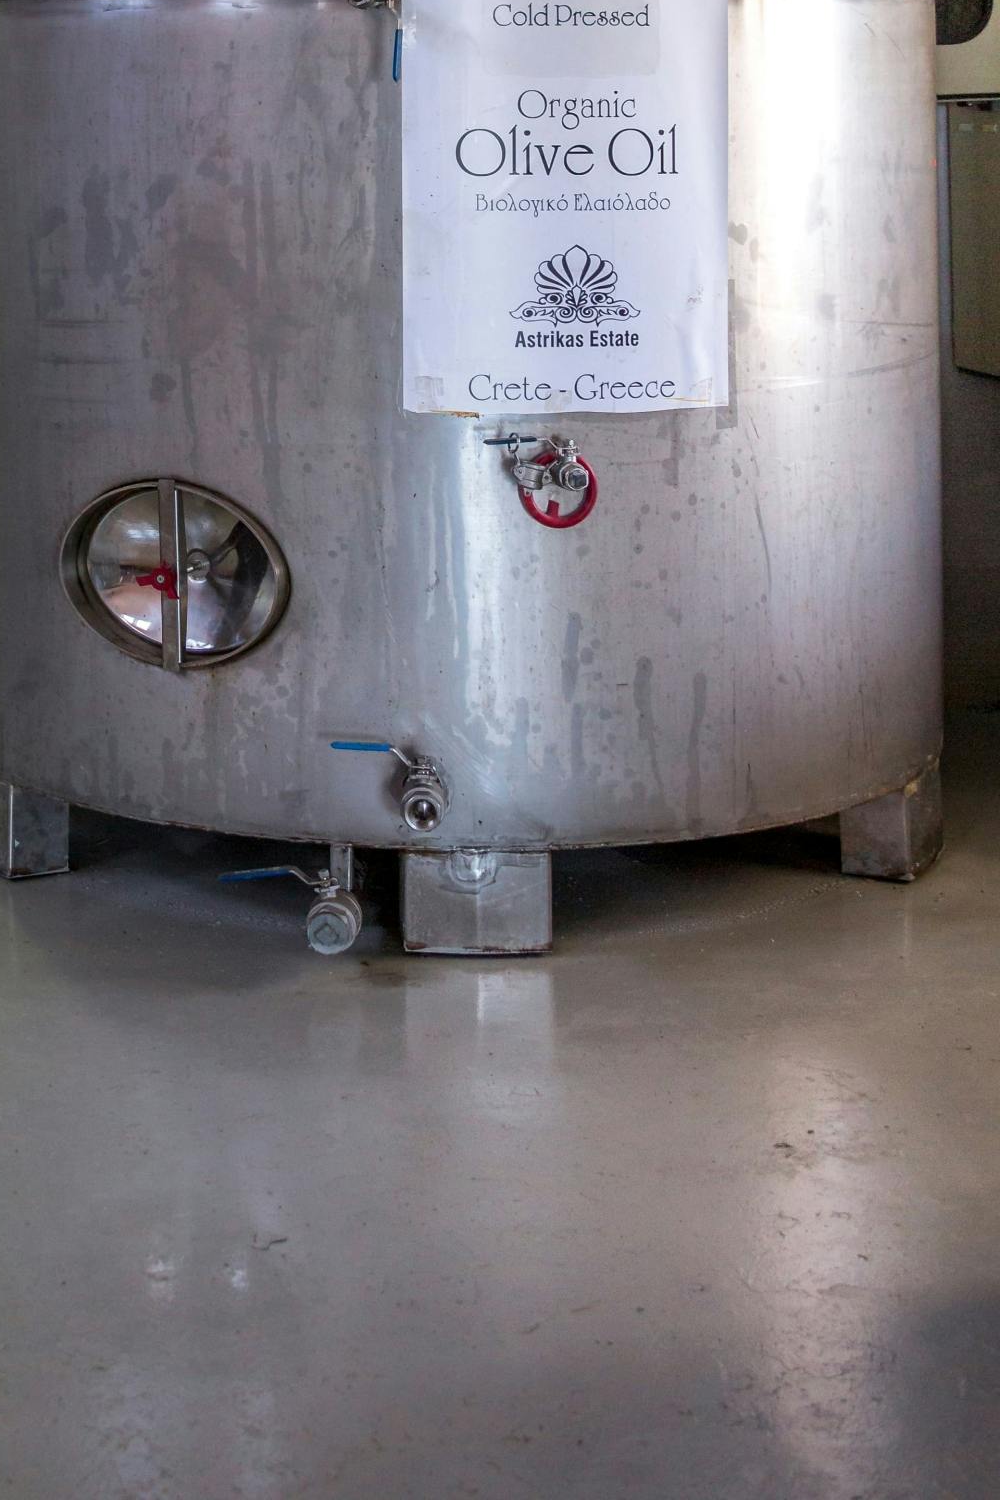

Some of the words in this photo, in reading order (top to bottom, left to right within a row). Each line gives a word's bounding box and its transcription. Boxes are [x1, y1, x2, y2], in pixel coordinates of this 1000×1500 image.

[492, 2, 550, 27] Cold
[554, 3, 651, 27] Pressed
[517, 89, 637, 130] Organic
[455, 124, 595, 177] Olive
[608, 124, 679, 177] Oil
[475, 192, 569, 217] Βιολογικό
[574, 191, 671, 212] Ελαιόλαδο
[515, 330, 584, 348] Astrikas
[589, 329, 639, 348] Estate
[468, 373, 552, 401] Crete
[574, 373, 676, 401] Greece
